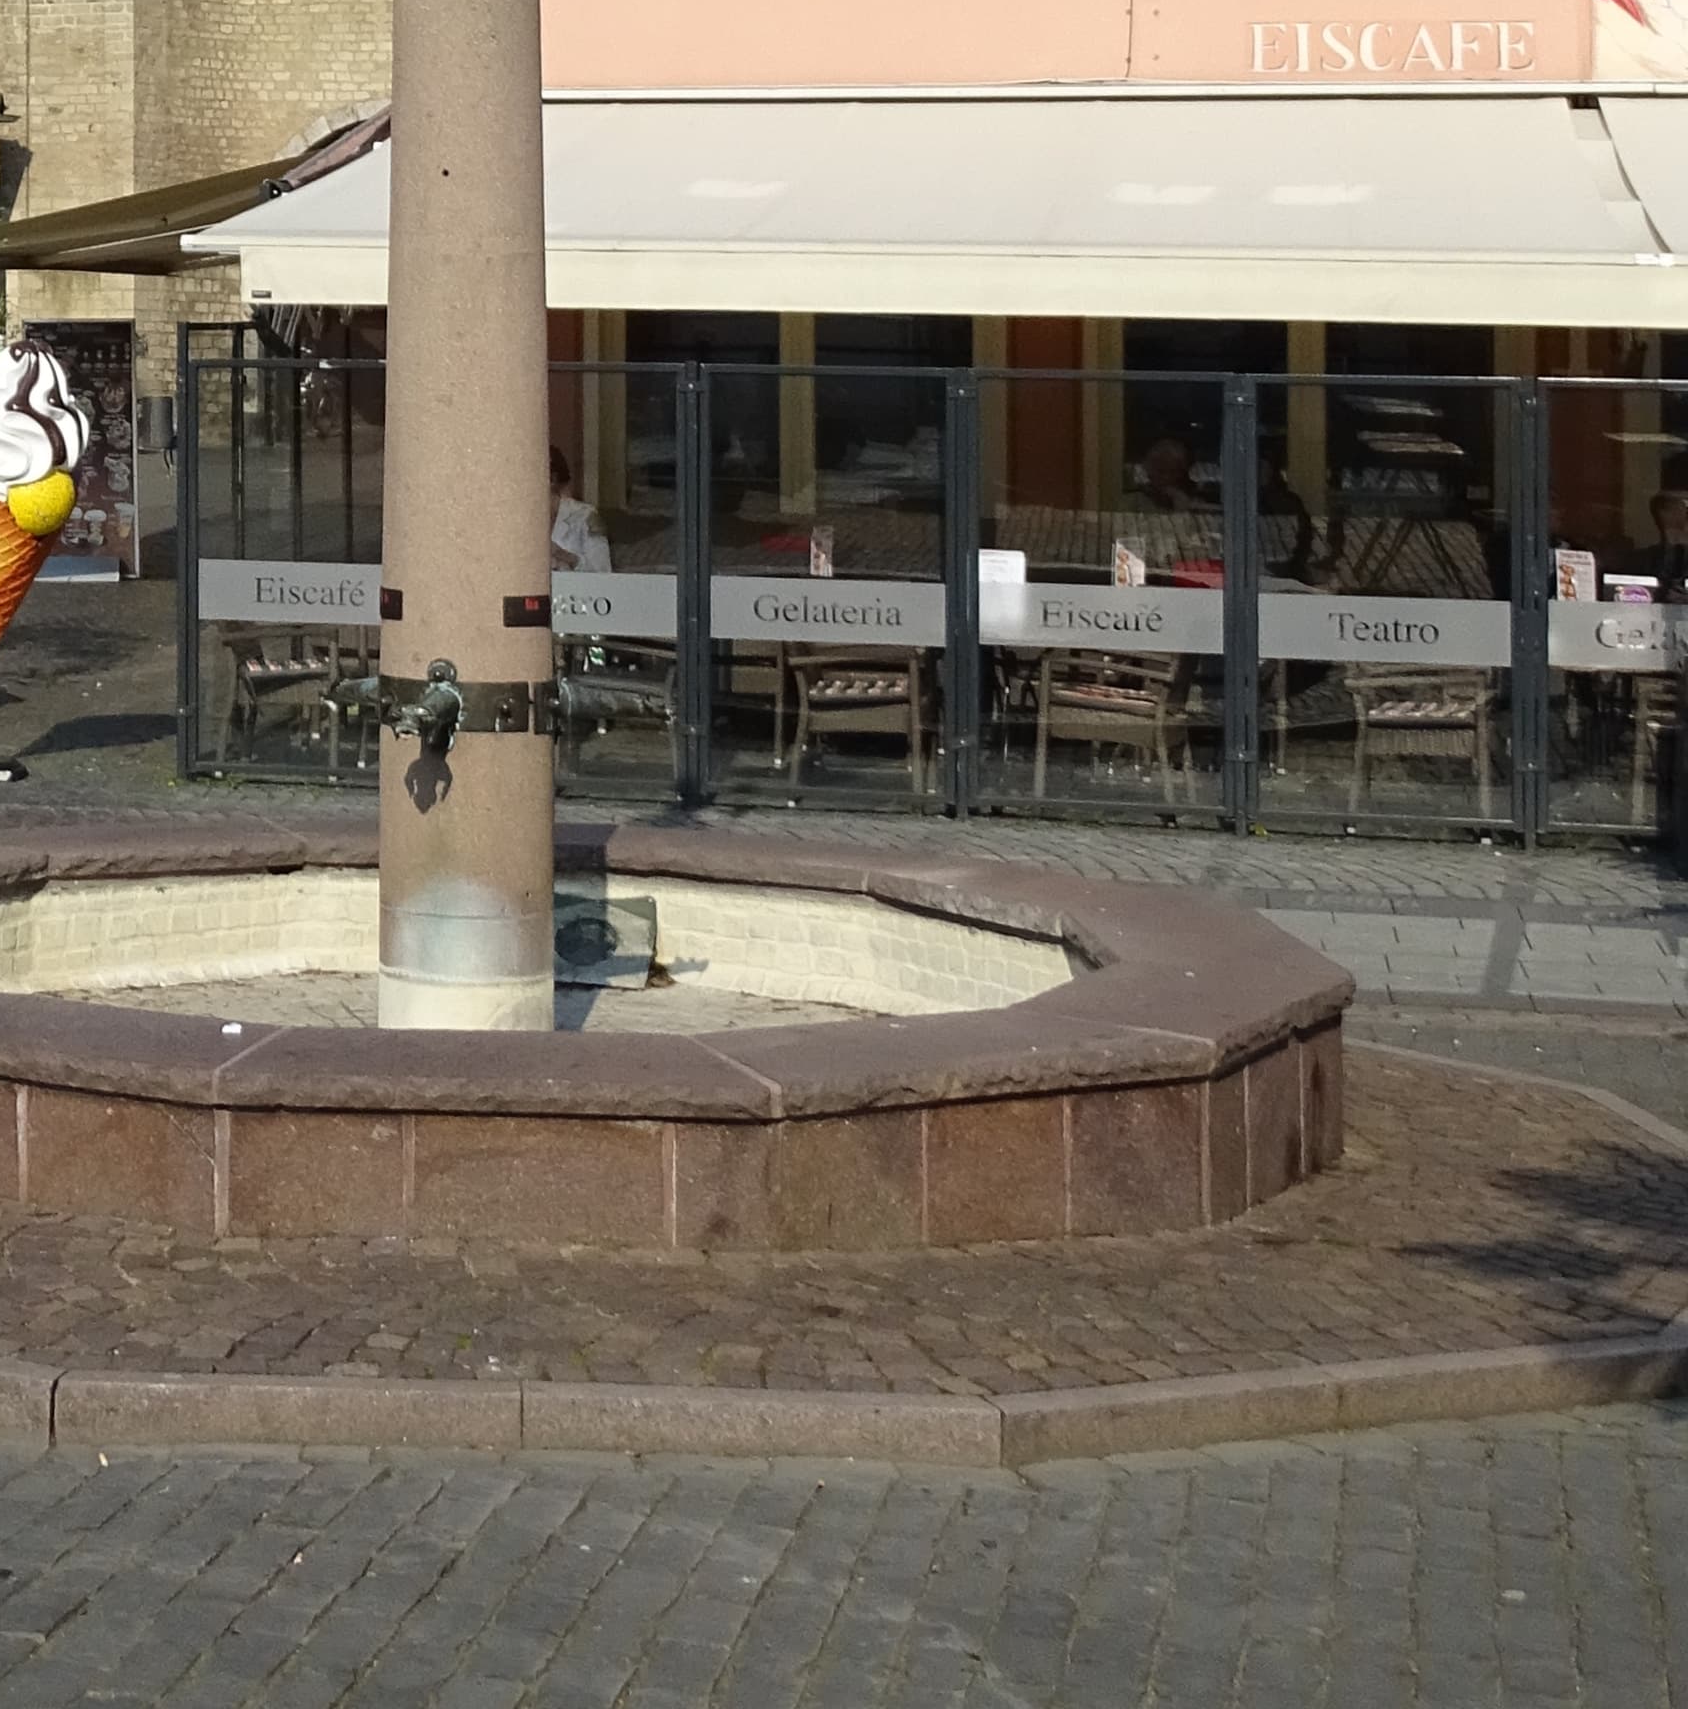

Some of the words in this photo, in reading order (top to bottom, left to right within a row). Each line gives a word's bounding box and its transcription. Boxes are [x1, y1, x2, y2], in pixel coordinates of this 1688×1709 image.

[1250, 21, 1536, 73] EISCAFE
[255, 576, 366, 608] Eiscafé
[752, 594, 903, 627] Gelateria
[1039, 599, 1164, 633] Eiscafé
[1327, 612, 1440, 646] Teatro
